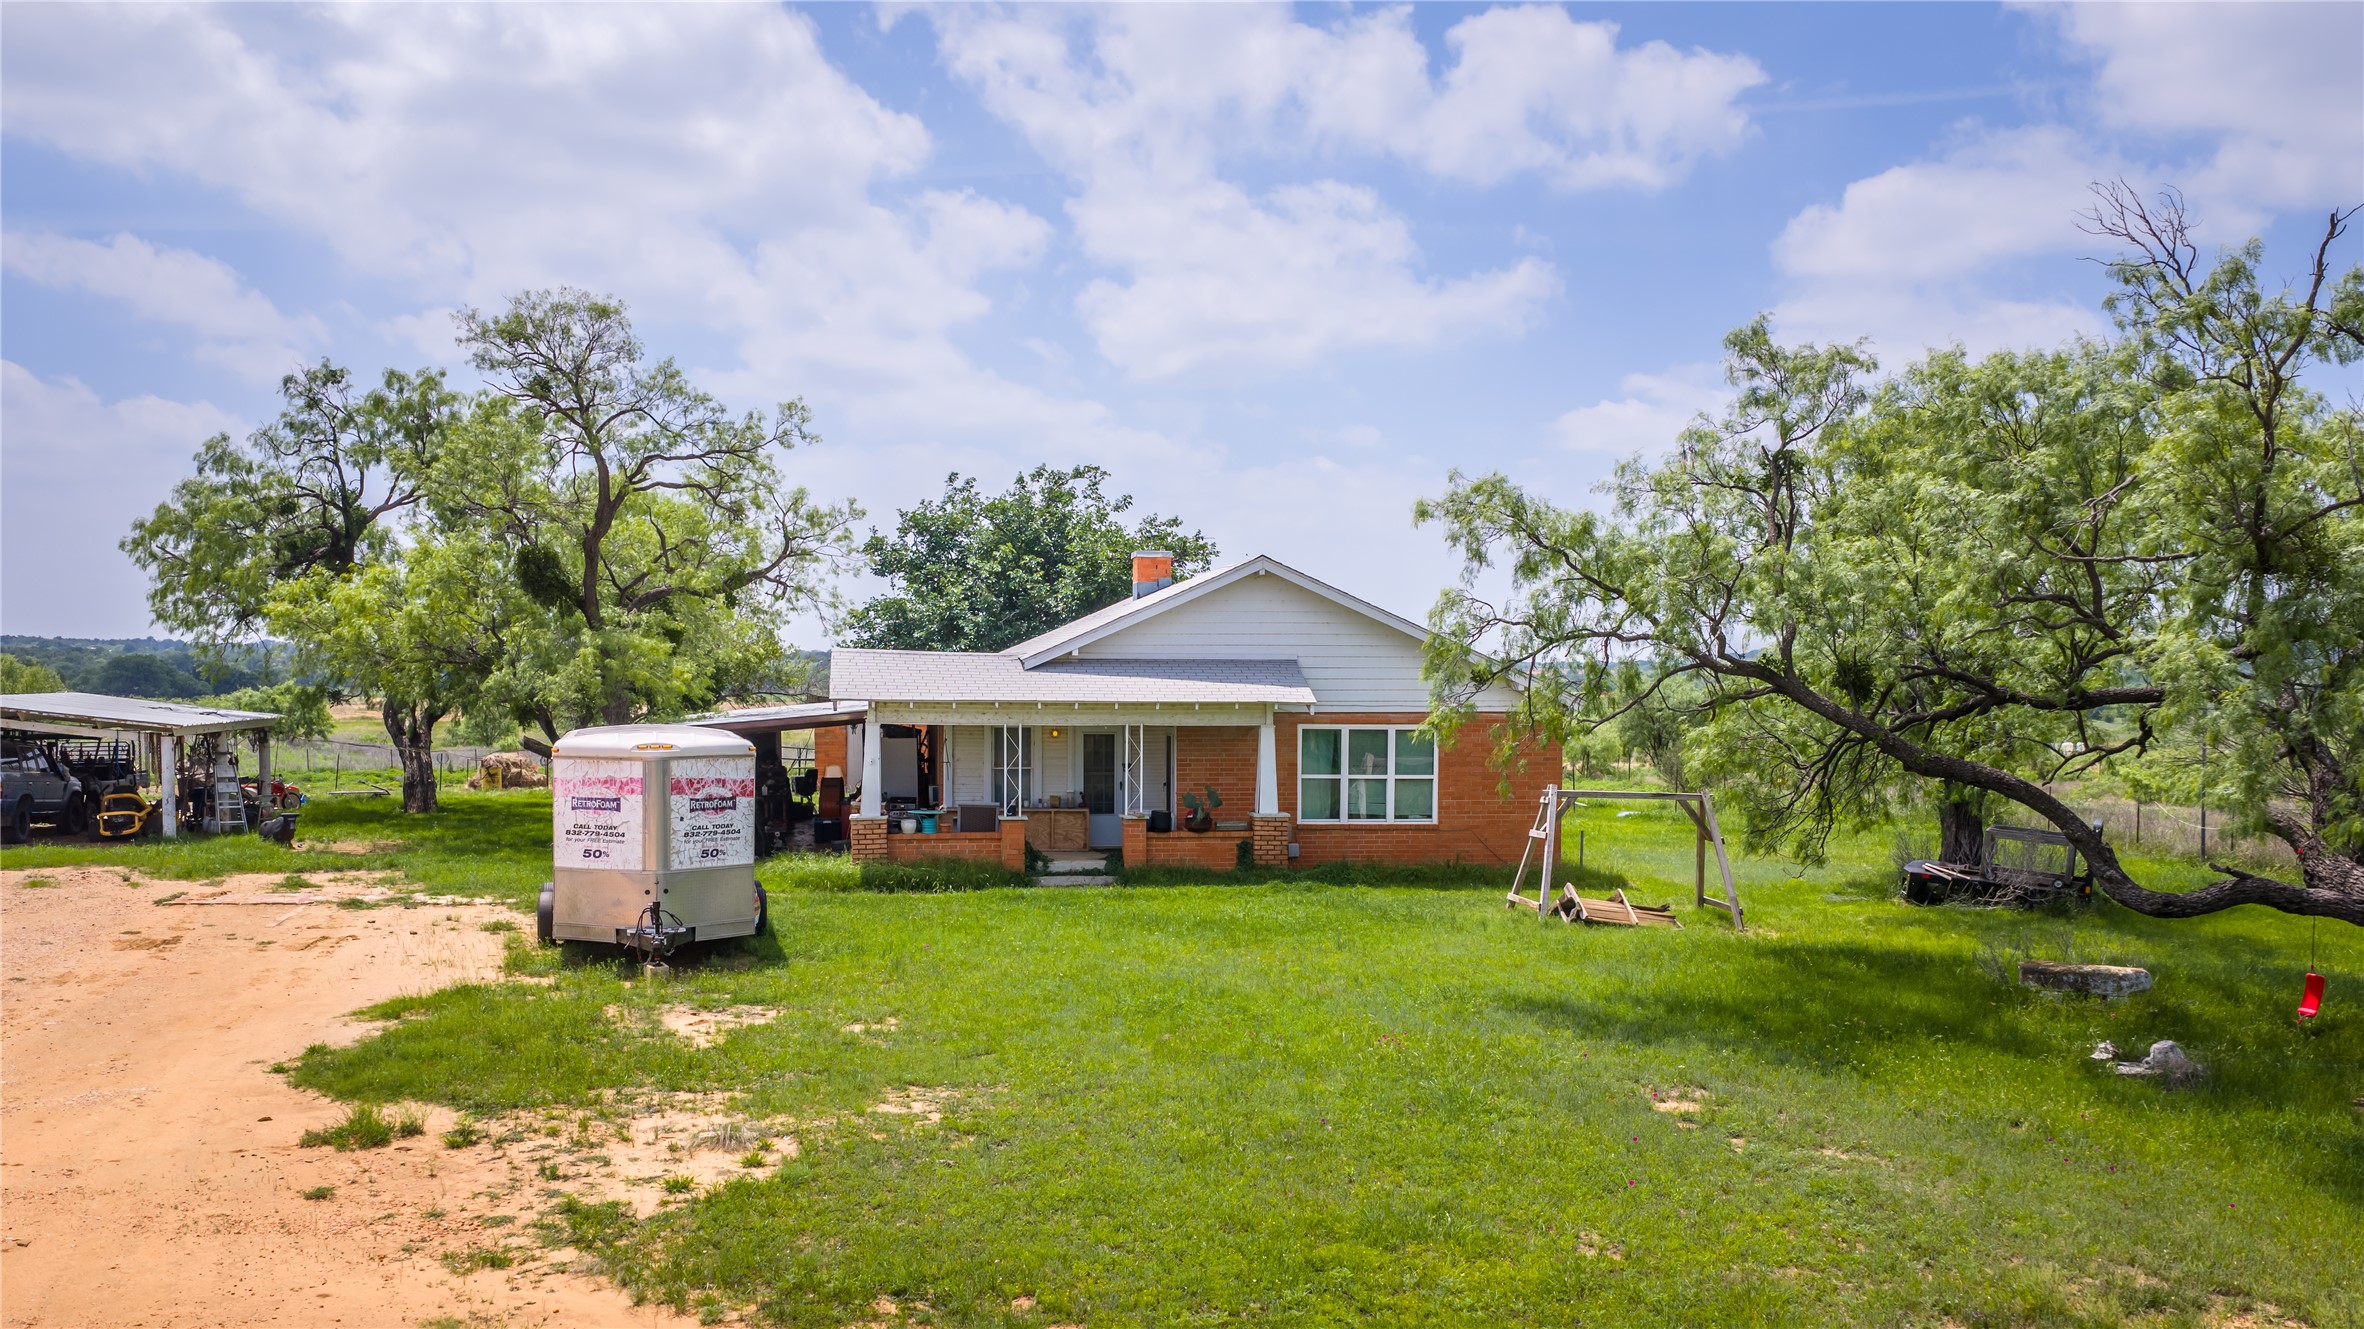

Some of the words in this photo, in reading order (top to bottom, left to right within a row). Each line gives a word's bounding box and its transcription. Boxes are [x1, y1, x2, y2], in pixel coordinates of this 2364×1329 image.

[565, 830, 626, 838] 832-779-4504
[684, 829, 741, 838] 832-779-4504
[582, 849, 610, 859] 50%
[700, 848, 726, 859] 50%
